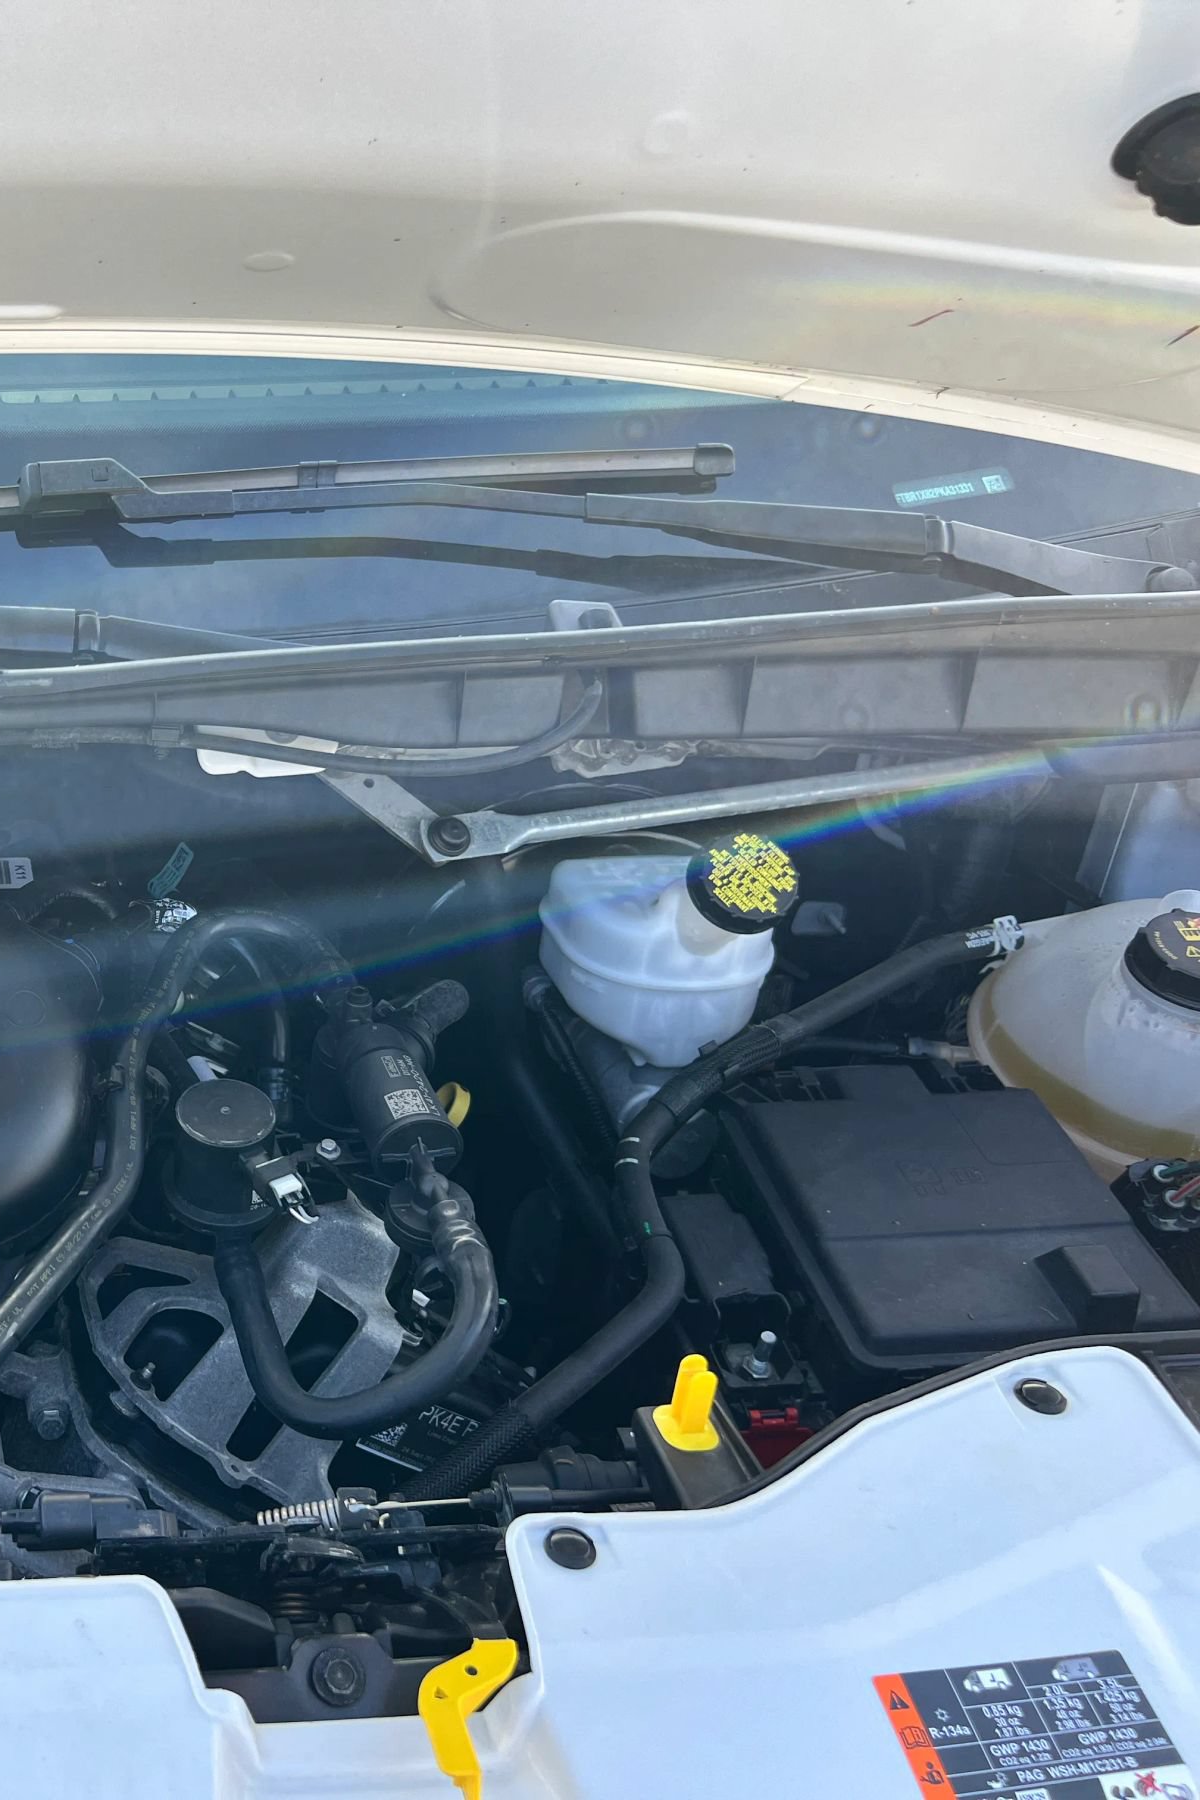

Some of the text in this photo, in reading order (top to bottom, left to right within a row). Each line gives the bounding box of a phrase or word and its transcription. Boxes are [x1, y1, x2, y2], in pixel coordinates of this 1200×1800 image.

[14, 864, 27, 880] K11
[1042, 1685, 1070, 1697] 2.0L
[1097, 1677, 1124, 1690] 3.5L
[1043, 1695, 1084, 1711] 1.35 kg
[1094, 1688, 1141, 1704] 1.425 kg
[982, 1703, 1024, 1718] 0.85 kg
[994, 1717, 1007, 1727] 30
[928, 1724, 972, 1740] R-134a
[1078, 1727, 1139, 1745] GWP 1430
[990, 1739, 1051, 1757] GWP 1430
[1016, 1769, 1046, 1783] PAG
